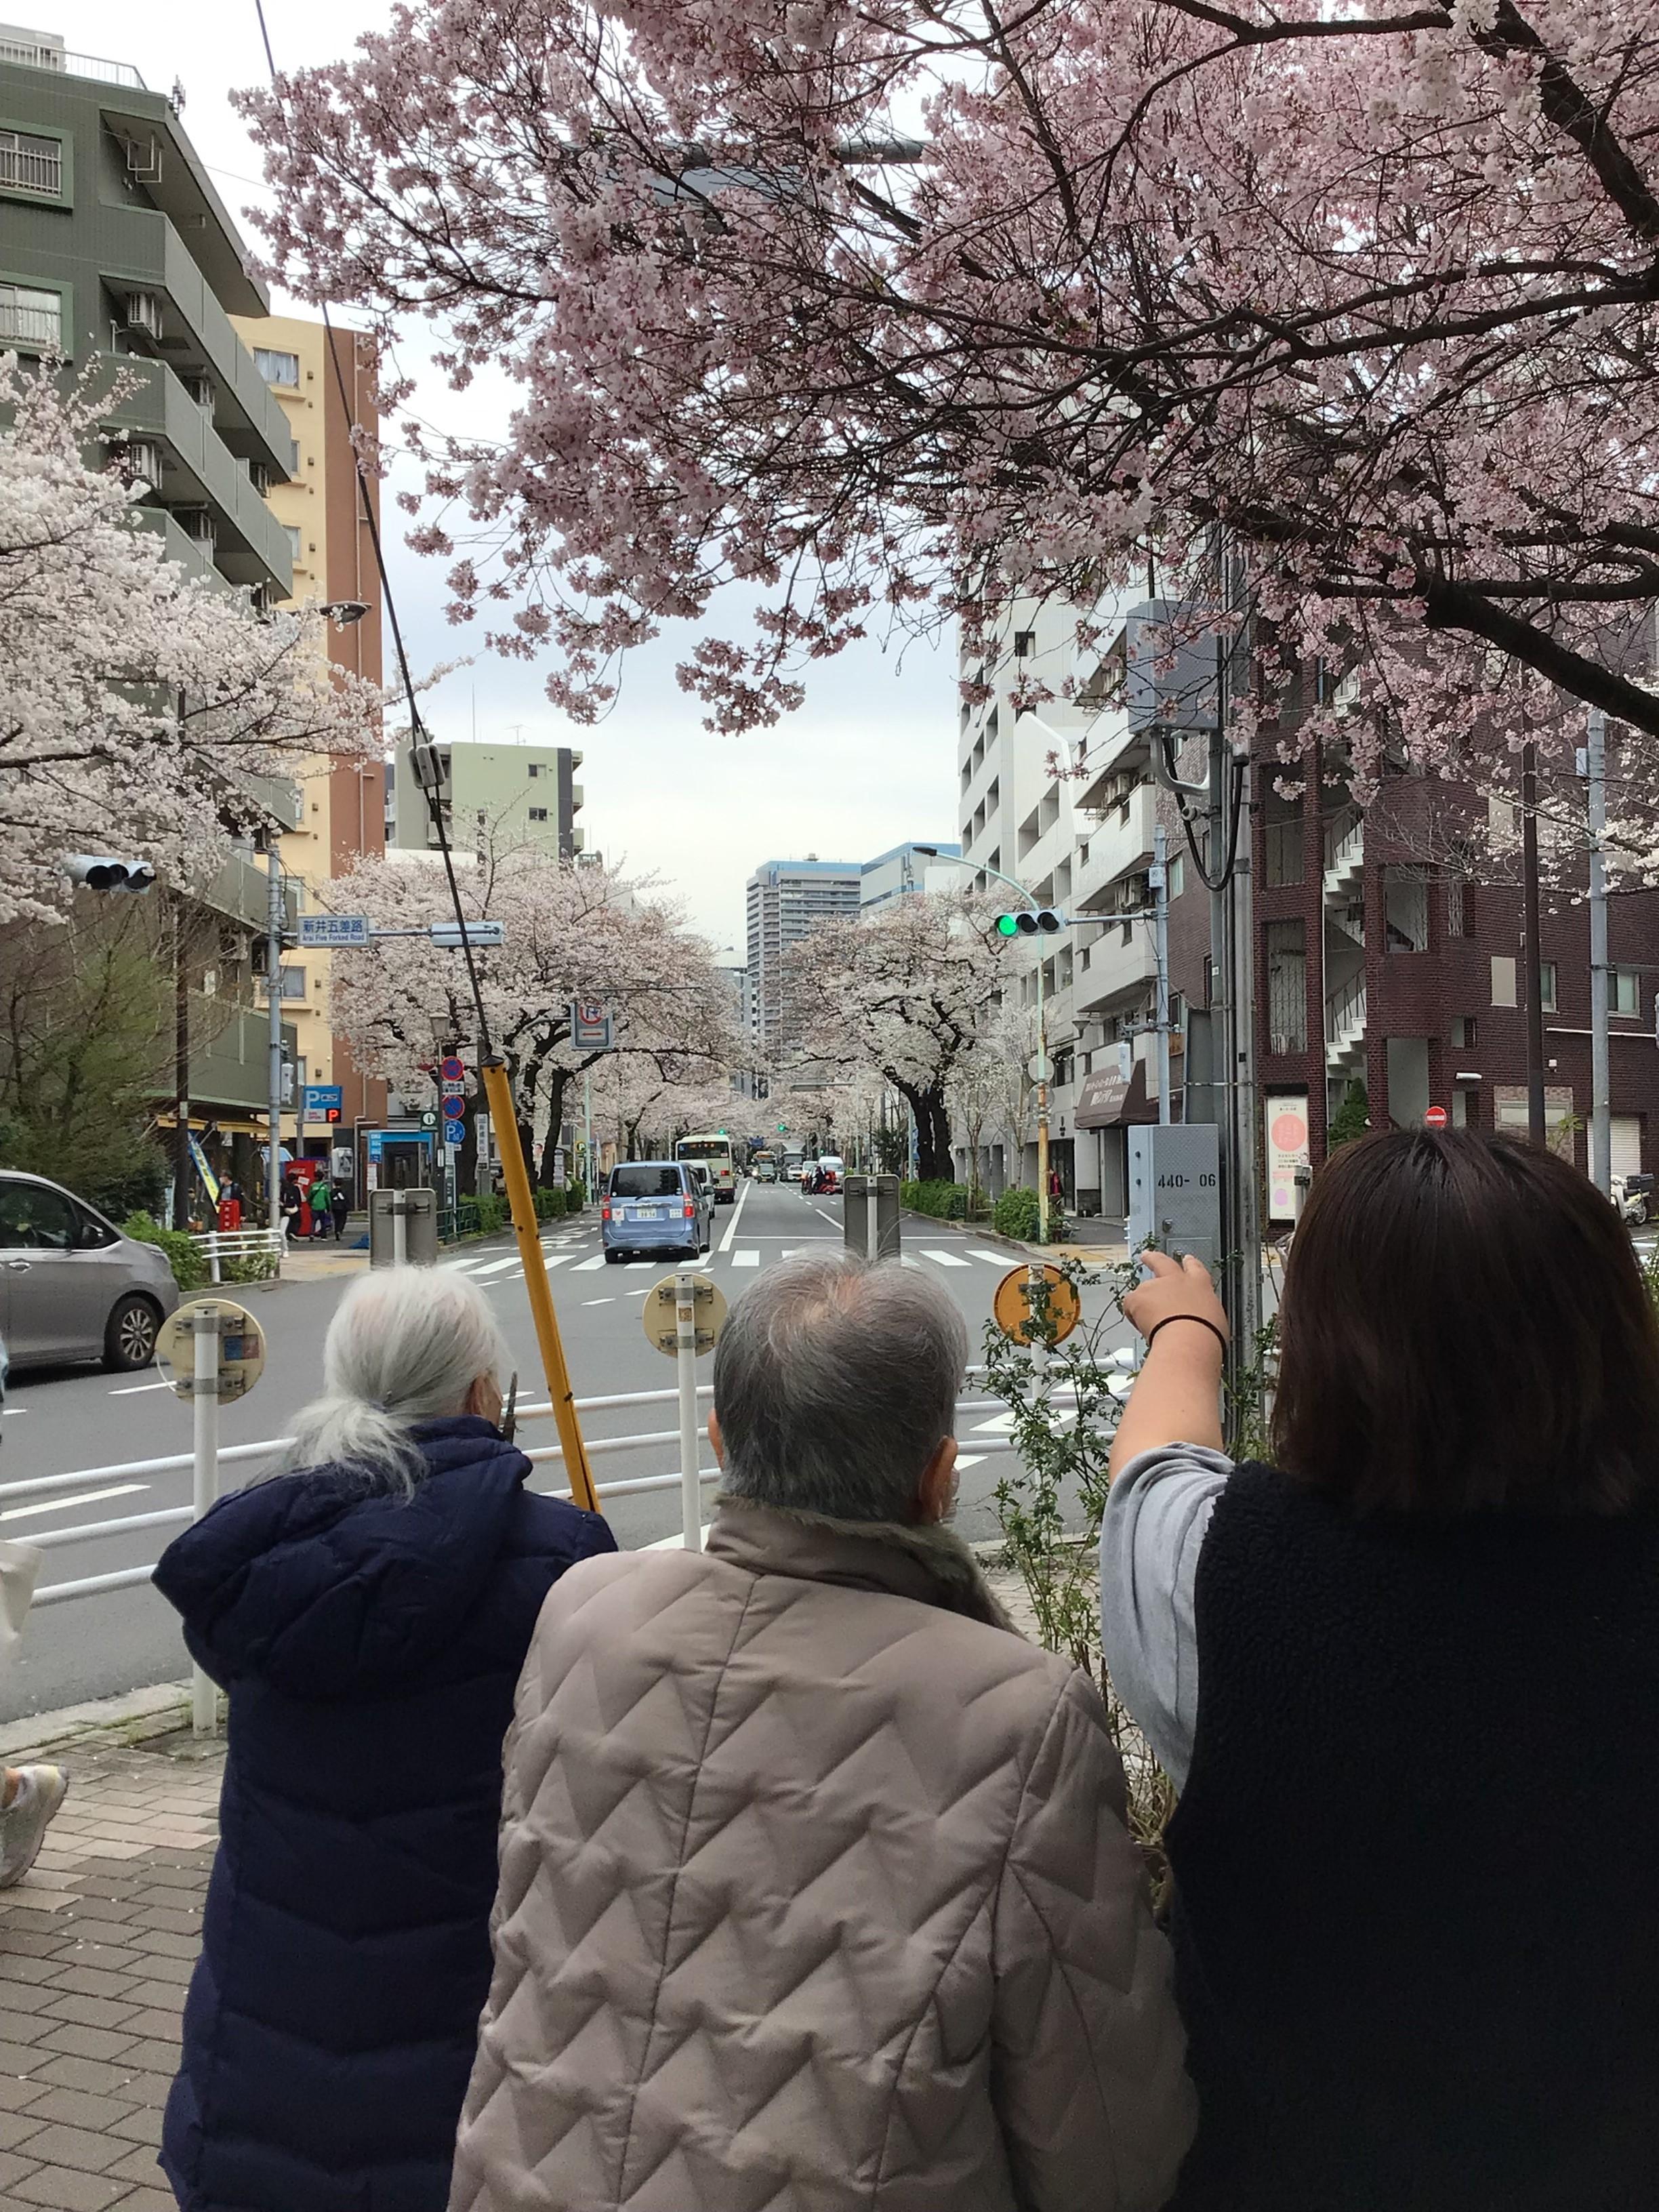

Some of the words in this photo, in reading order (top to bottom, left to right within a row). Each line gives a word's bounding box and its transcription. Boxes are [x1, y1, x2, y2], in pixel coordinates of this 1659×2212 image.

[303, 920, 363, 933] 新井五差路
[306, 1090, 321, 1109] P
[329, 1109, 338, 1122] P
[447, 1126, 455, 1141] P
[1158, 1174, 1189, 1188] 440-
[1200, 1174, 1216, 1187] 06
